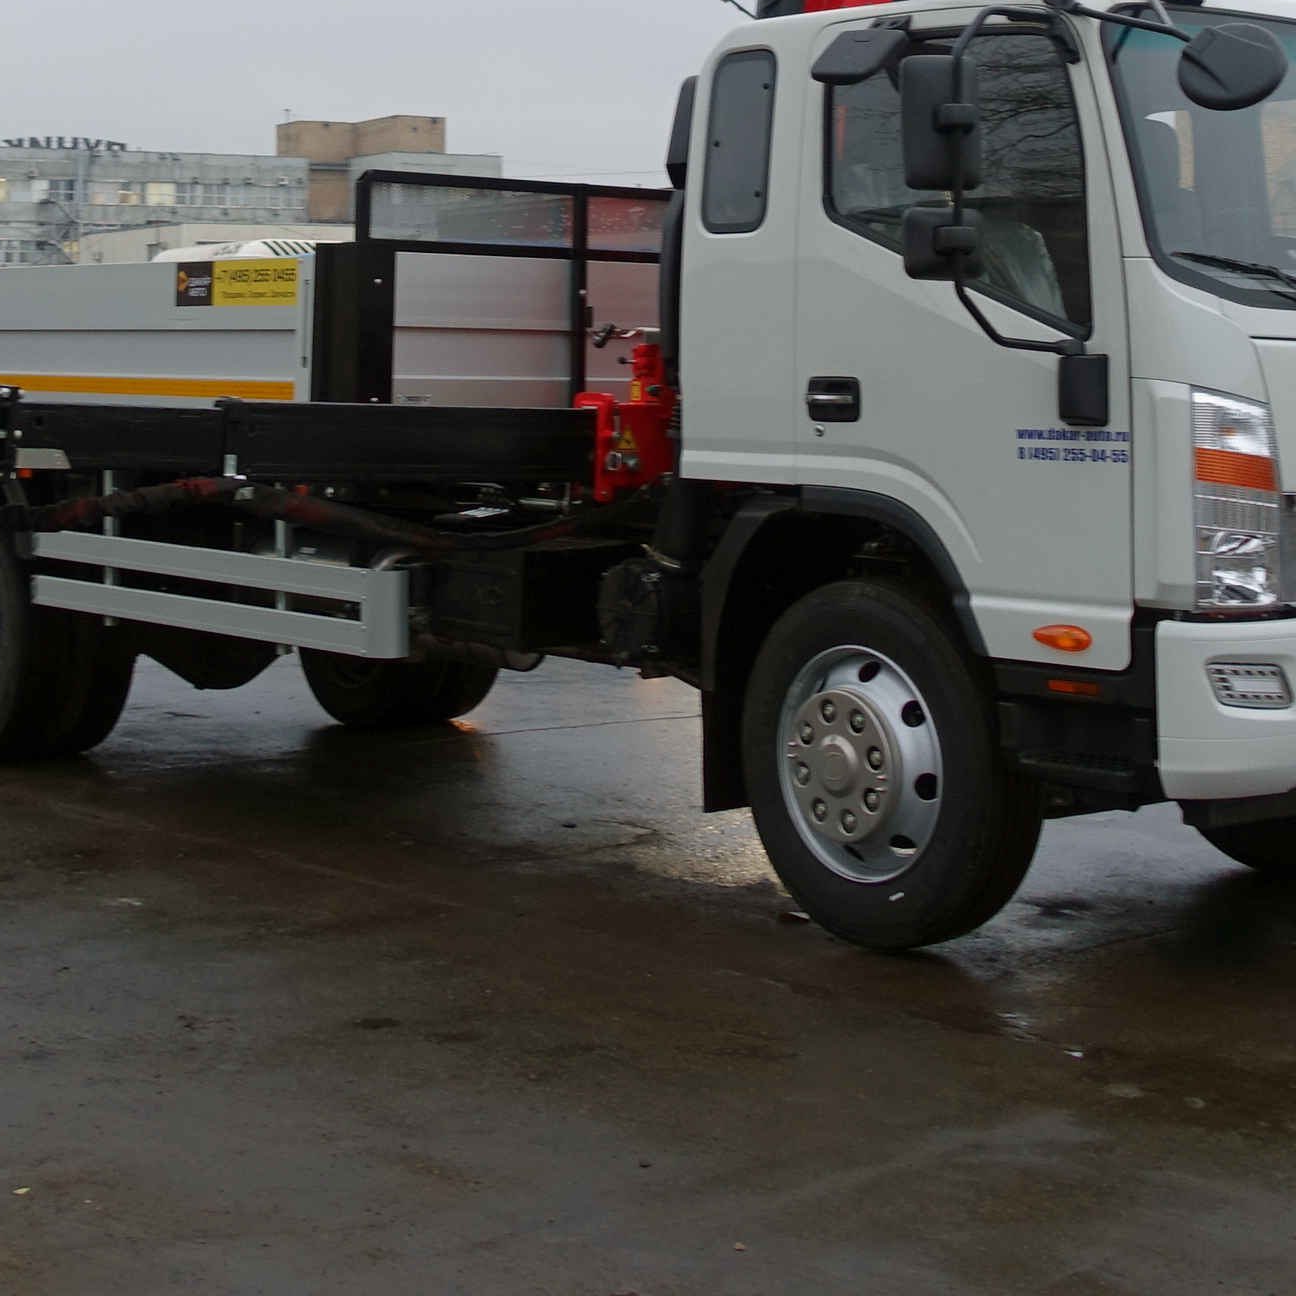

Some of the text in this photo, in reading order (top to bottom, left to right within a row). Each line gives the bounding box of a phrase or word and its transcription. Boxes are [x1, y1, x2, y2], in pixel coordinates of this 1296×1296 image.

[1016, 428, 1129, 442] www.dakar-auto.ru
[1018, 446, 1129, 463] 8 (495) 255-04-55
